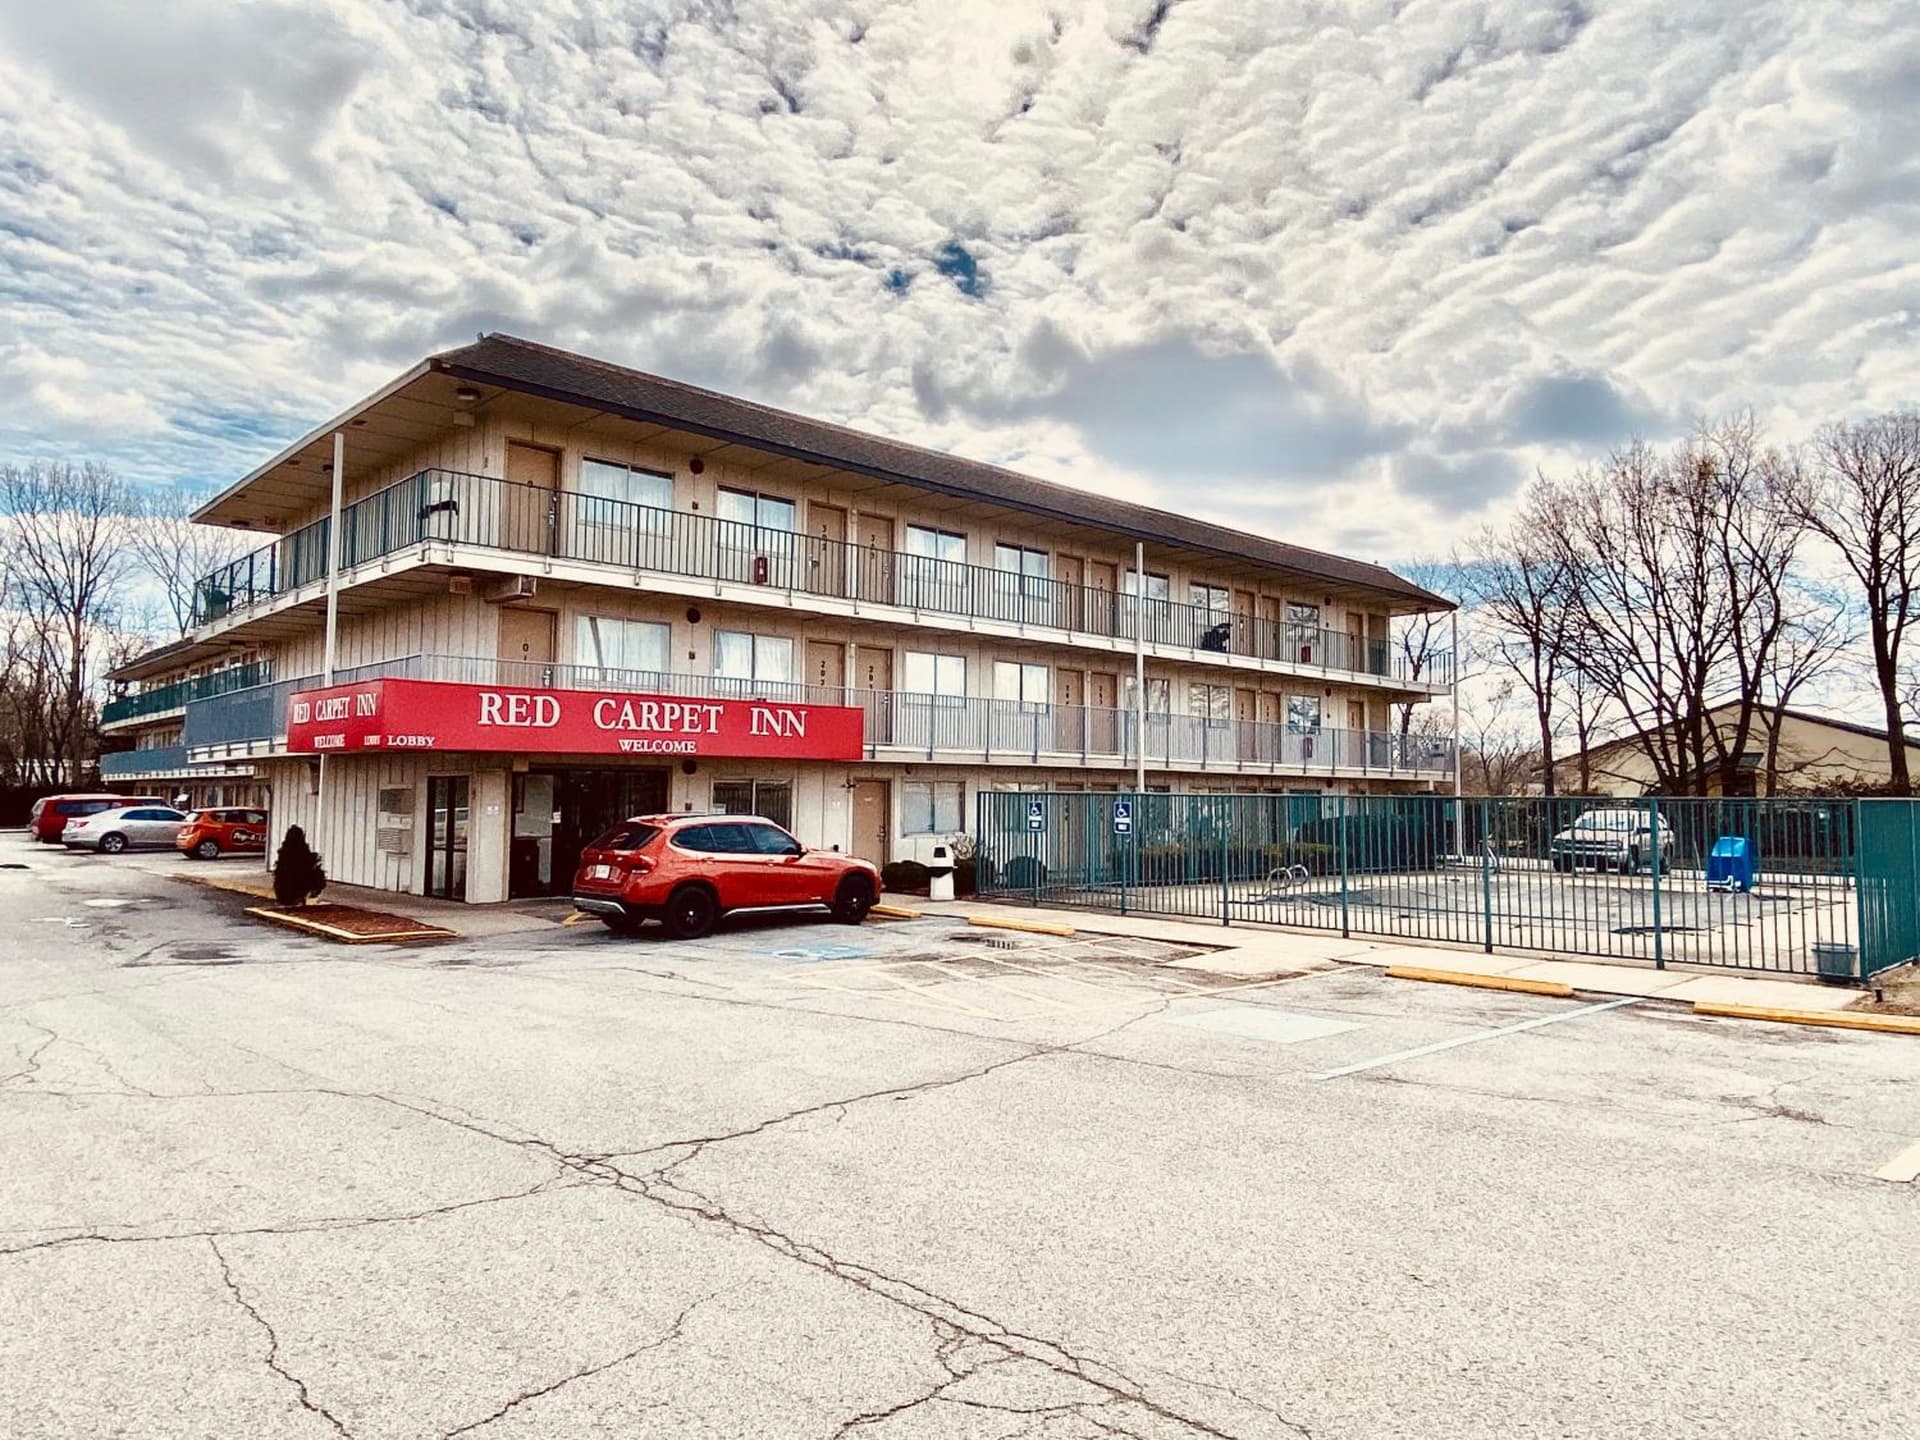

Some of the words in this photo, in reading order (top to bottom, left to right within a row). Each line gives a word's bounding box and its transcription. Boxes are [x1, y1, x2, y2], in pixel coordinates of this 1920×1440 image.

[293, 702, 310, 724] RED
[315, 696, 350, 722] CARPET
[356, 693, 377, 717] INN
[478, 692, 561, 728] RED
[593, 699, 724, 735] CARPET
[750, 707, 807, 738] INN
[314, 734, 345, 749] WELCOME
[387, 735, 436, 747] LOBBY
[618, 739, 697, 754] WELCOME
